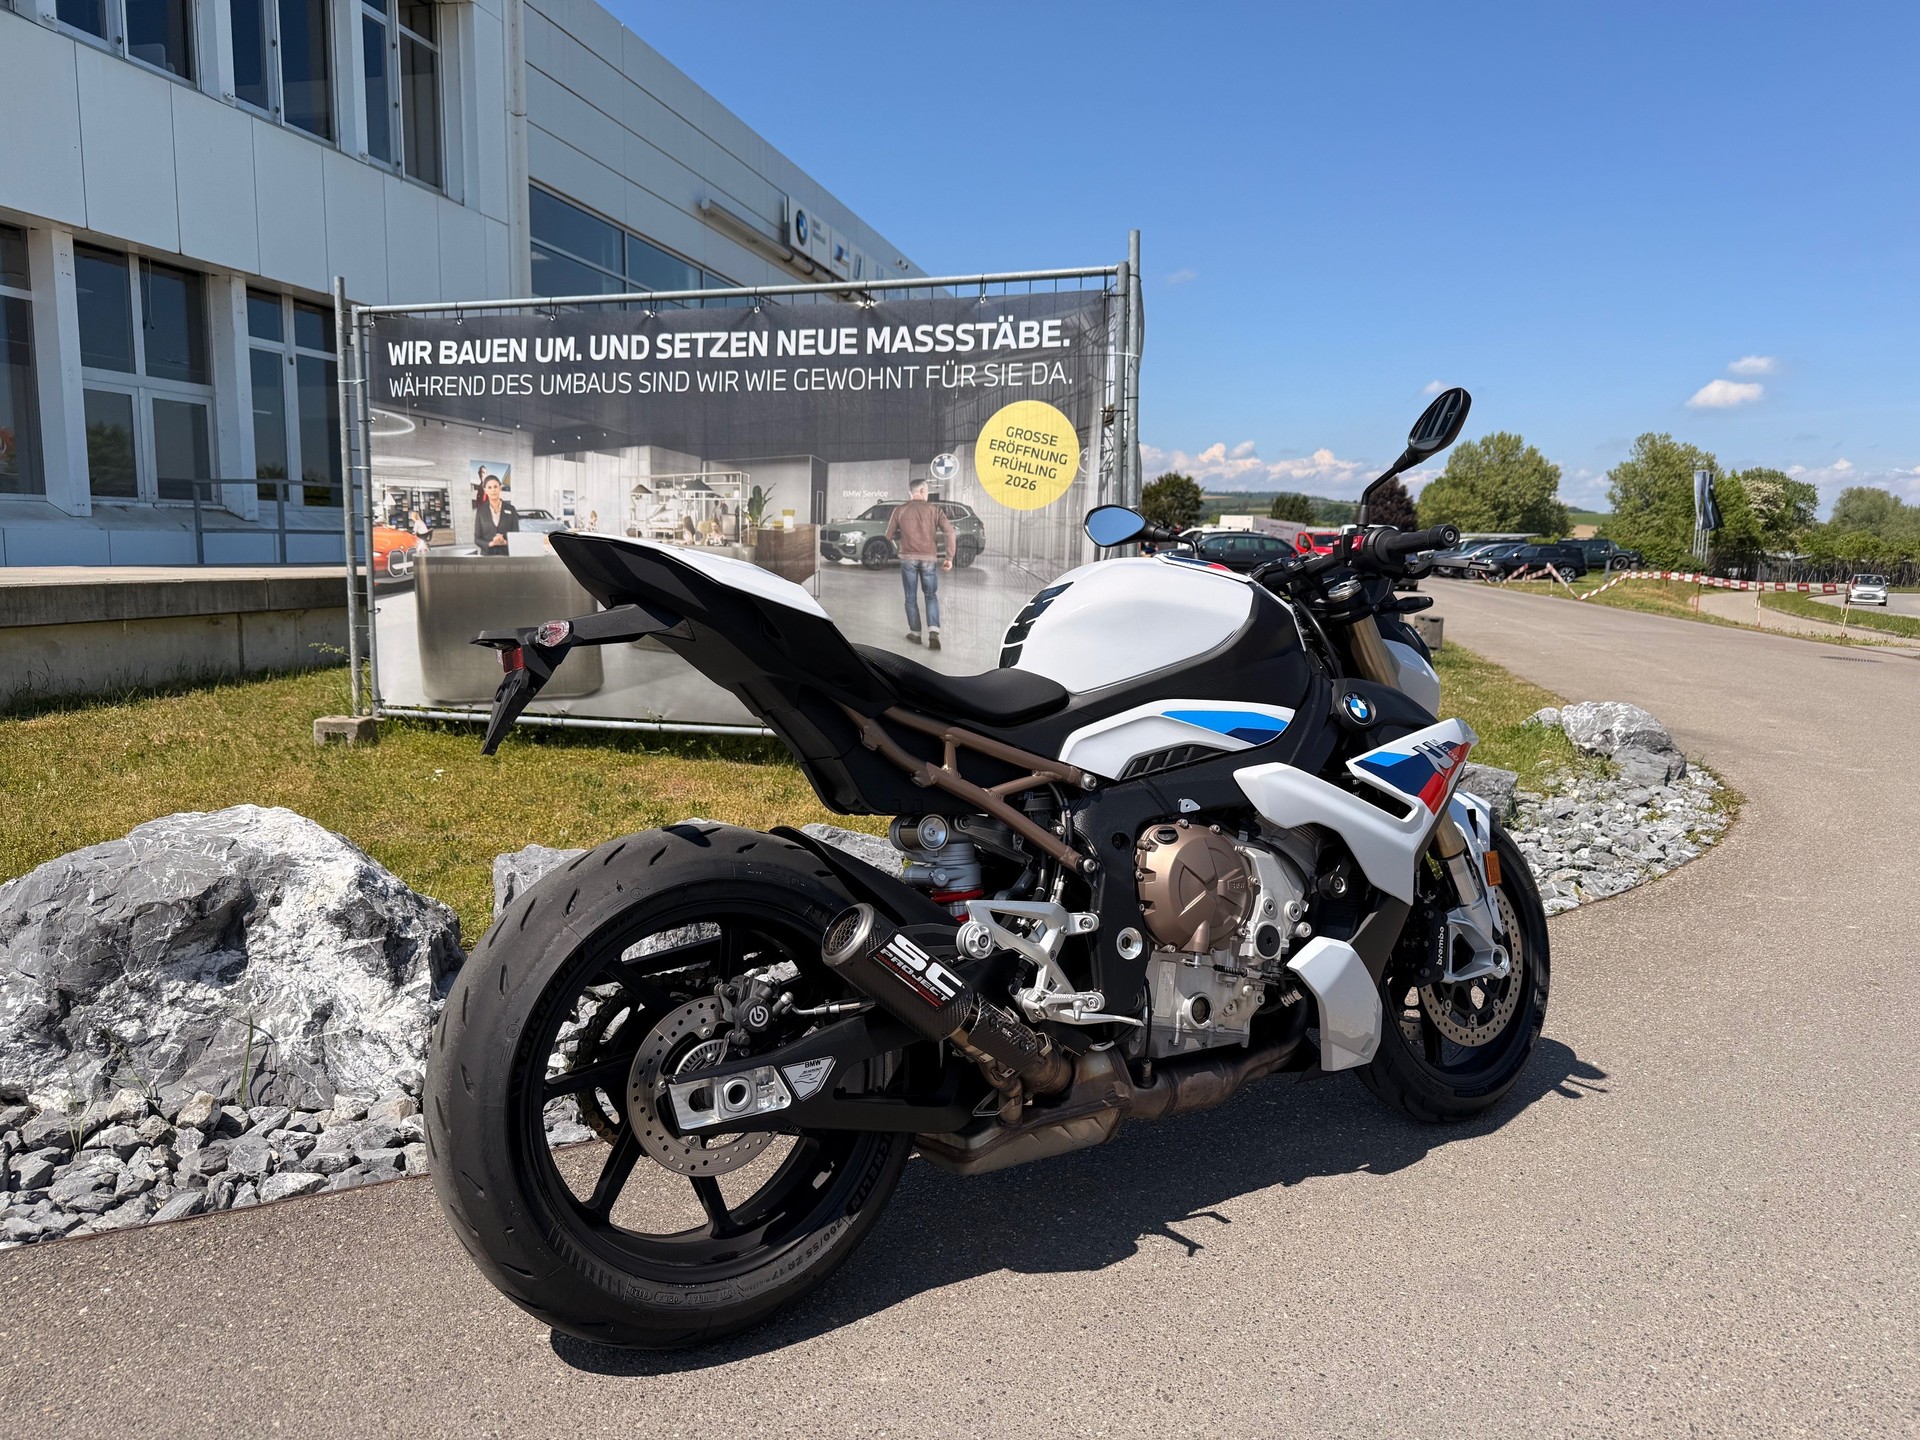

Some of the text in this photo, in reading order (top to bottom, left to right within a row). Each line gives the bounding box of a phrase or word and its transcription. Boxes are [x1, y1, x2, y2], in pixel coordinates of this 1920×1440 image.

[388, 315, 1070, 366] WIR BAUEN UM. UND SETZEN NEUE MASSSTÄBE.
[389, 360, 1073, 398] WÄHREND DES UMBAUS SIND WIR WIE GEWOHNT FÜR SIE DA.
[1006, 426, 1059, 447] GROSSE
[989, 439, 1068, 465] ERÖFFNUNG
[992, 455, 1058, 479] FRÜHLING
[842, 489, 889, 498] BMW Service
[1005, 474, 1037, 491] 2026
[1438, 744, 1460, 761] 1000
[1436, 926, 1445, 965] brembo
[879, 947, 951, 1002] PROJECT
[886, 933, 963, 998] SC
[804, 1059, 822, 1068] BMW
[804, 1219, 843, 1258] 200/55
[772, 1267, 786, 1281] 17
[786, 1255, 805, 1271] ZR
